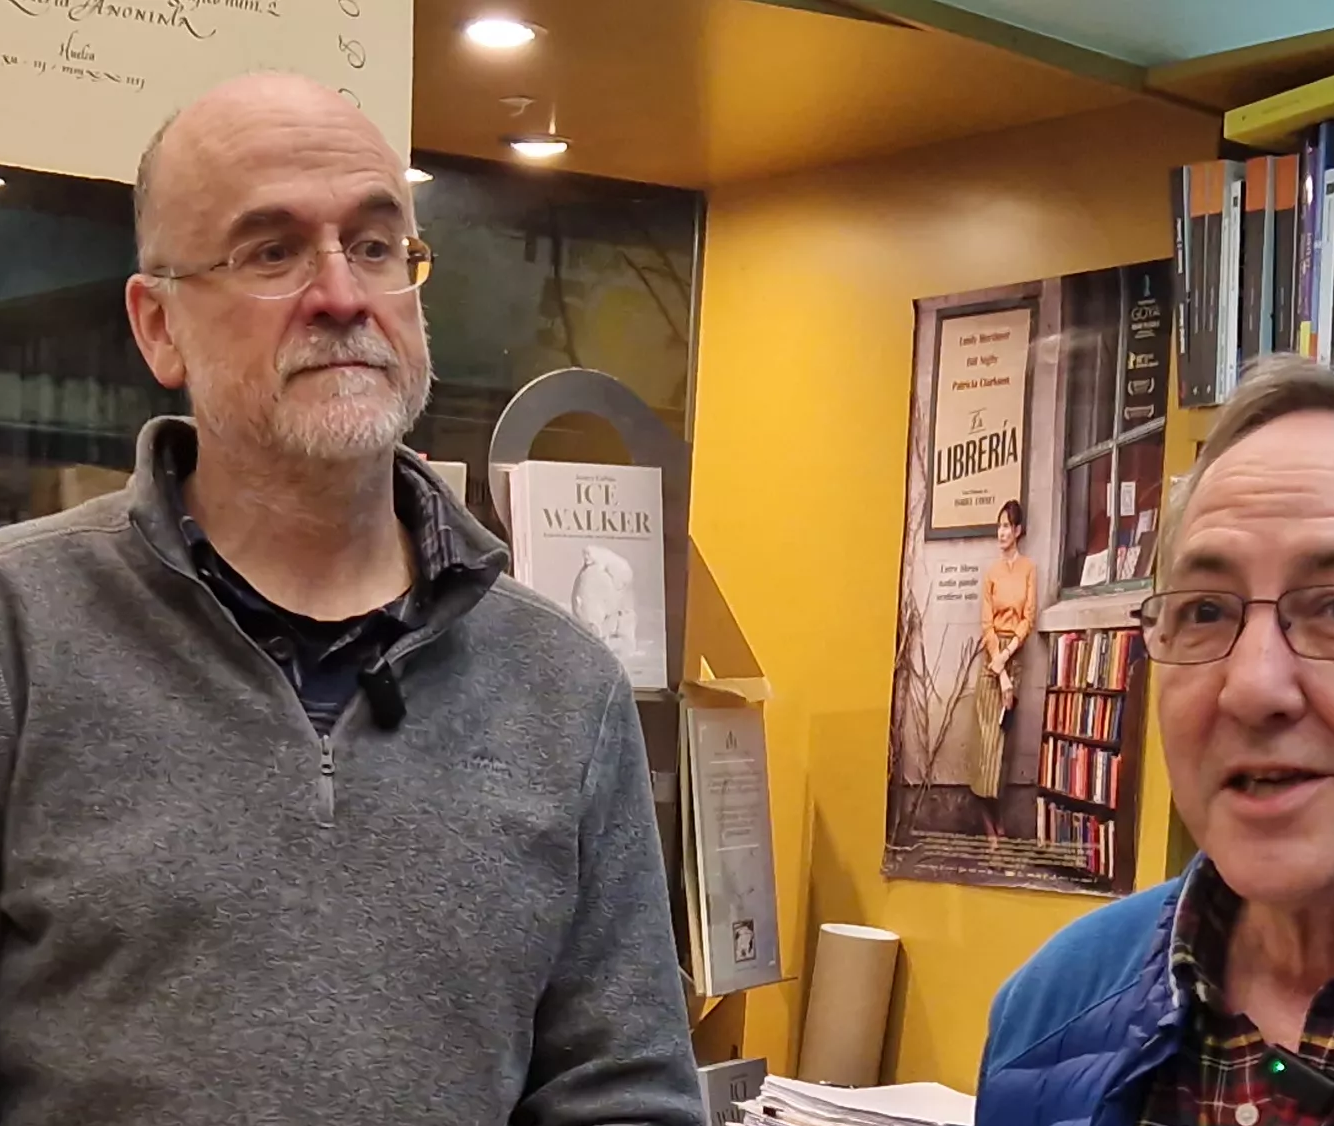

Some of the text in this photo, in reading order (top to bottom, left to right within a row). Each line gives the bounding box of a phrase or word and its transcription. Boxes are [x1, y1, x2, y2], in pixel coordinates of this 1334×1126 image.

[952, 376, 1010, 390] Patricia Clarkson
[936, 419, 1018, 485] LIBRERÍA
[576, 483, 619, 506] ICE
[543, 508, 651, 534] WALKER
